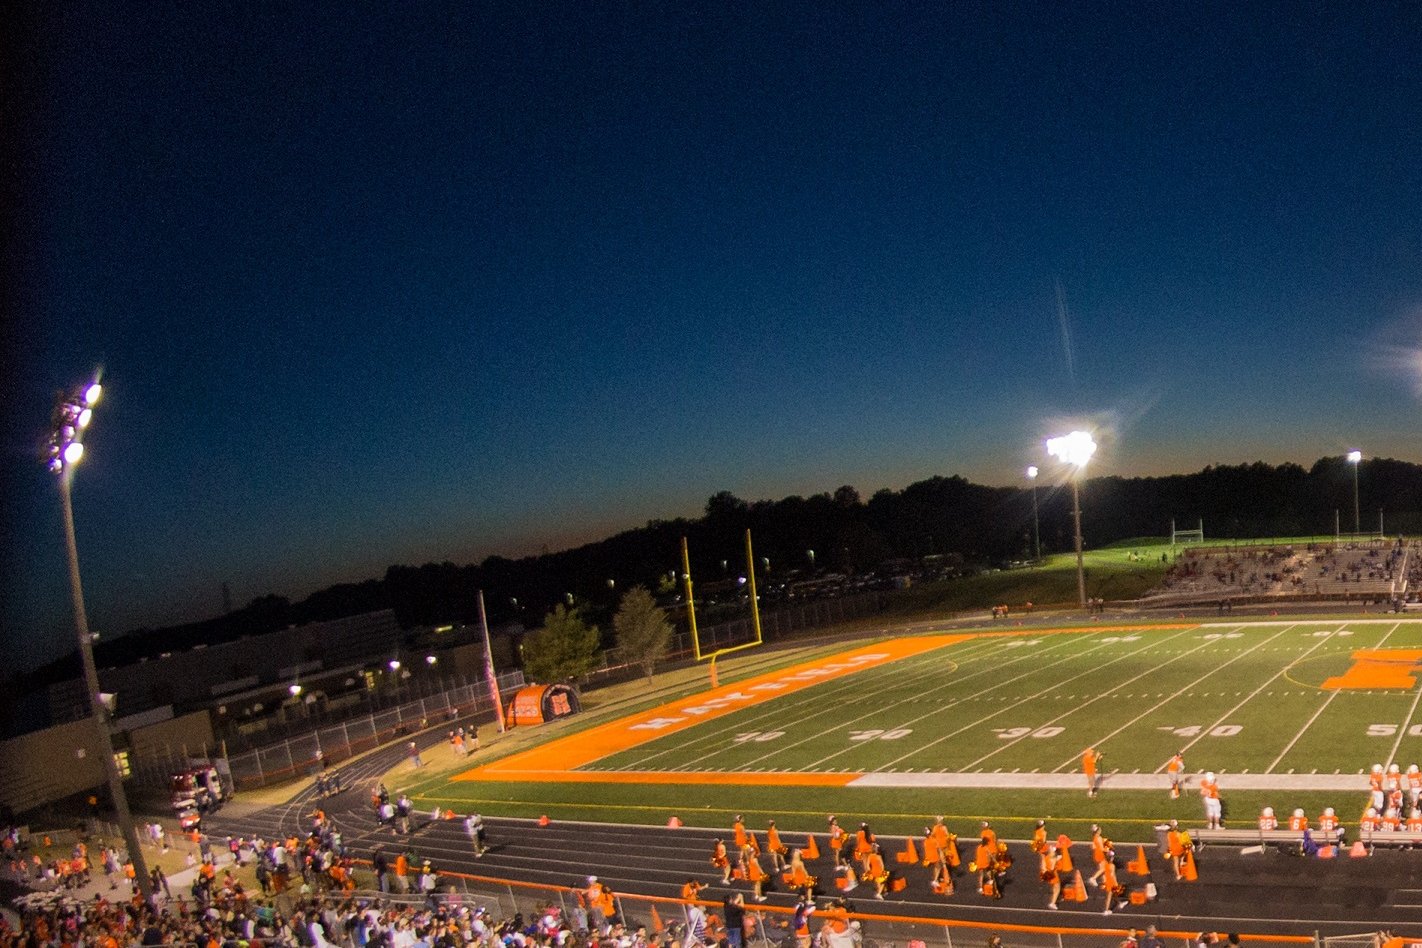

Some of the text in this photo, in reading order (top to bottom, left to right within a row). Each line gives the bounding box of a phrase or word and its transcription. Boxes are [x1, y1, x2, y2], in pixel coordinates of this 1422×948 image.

[849, 729, 914, 740] 20
[997, 727, 1066, 738] 30
[1172, 724, 1244, 737] 40
